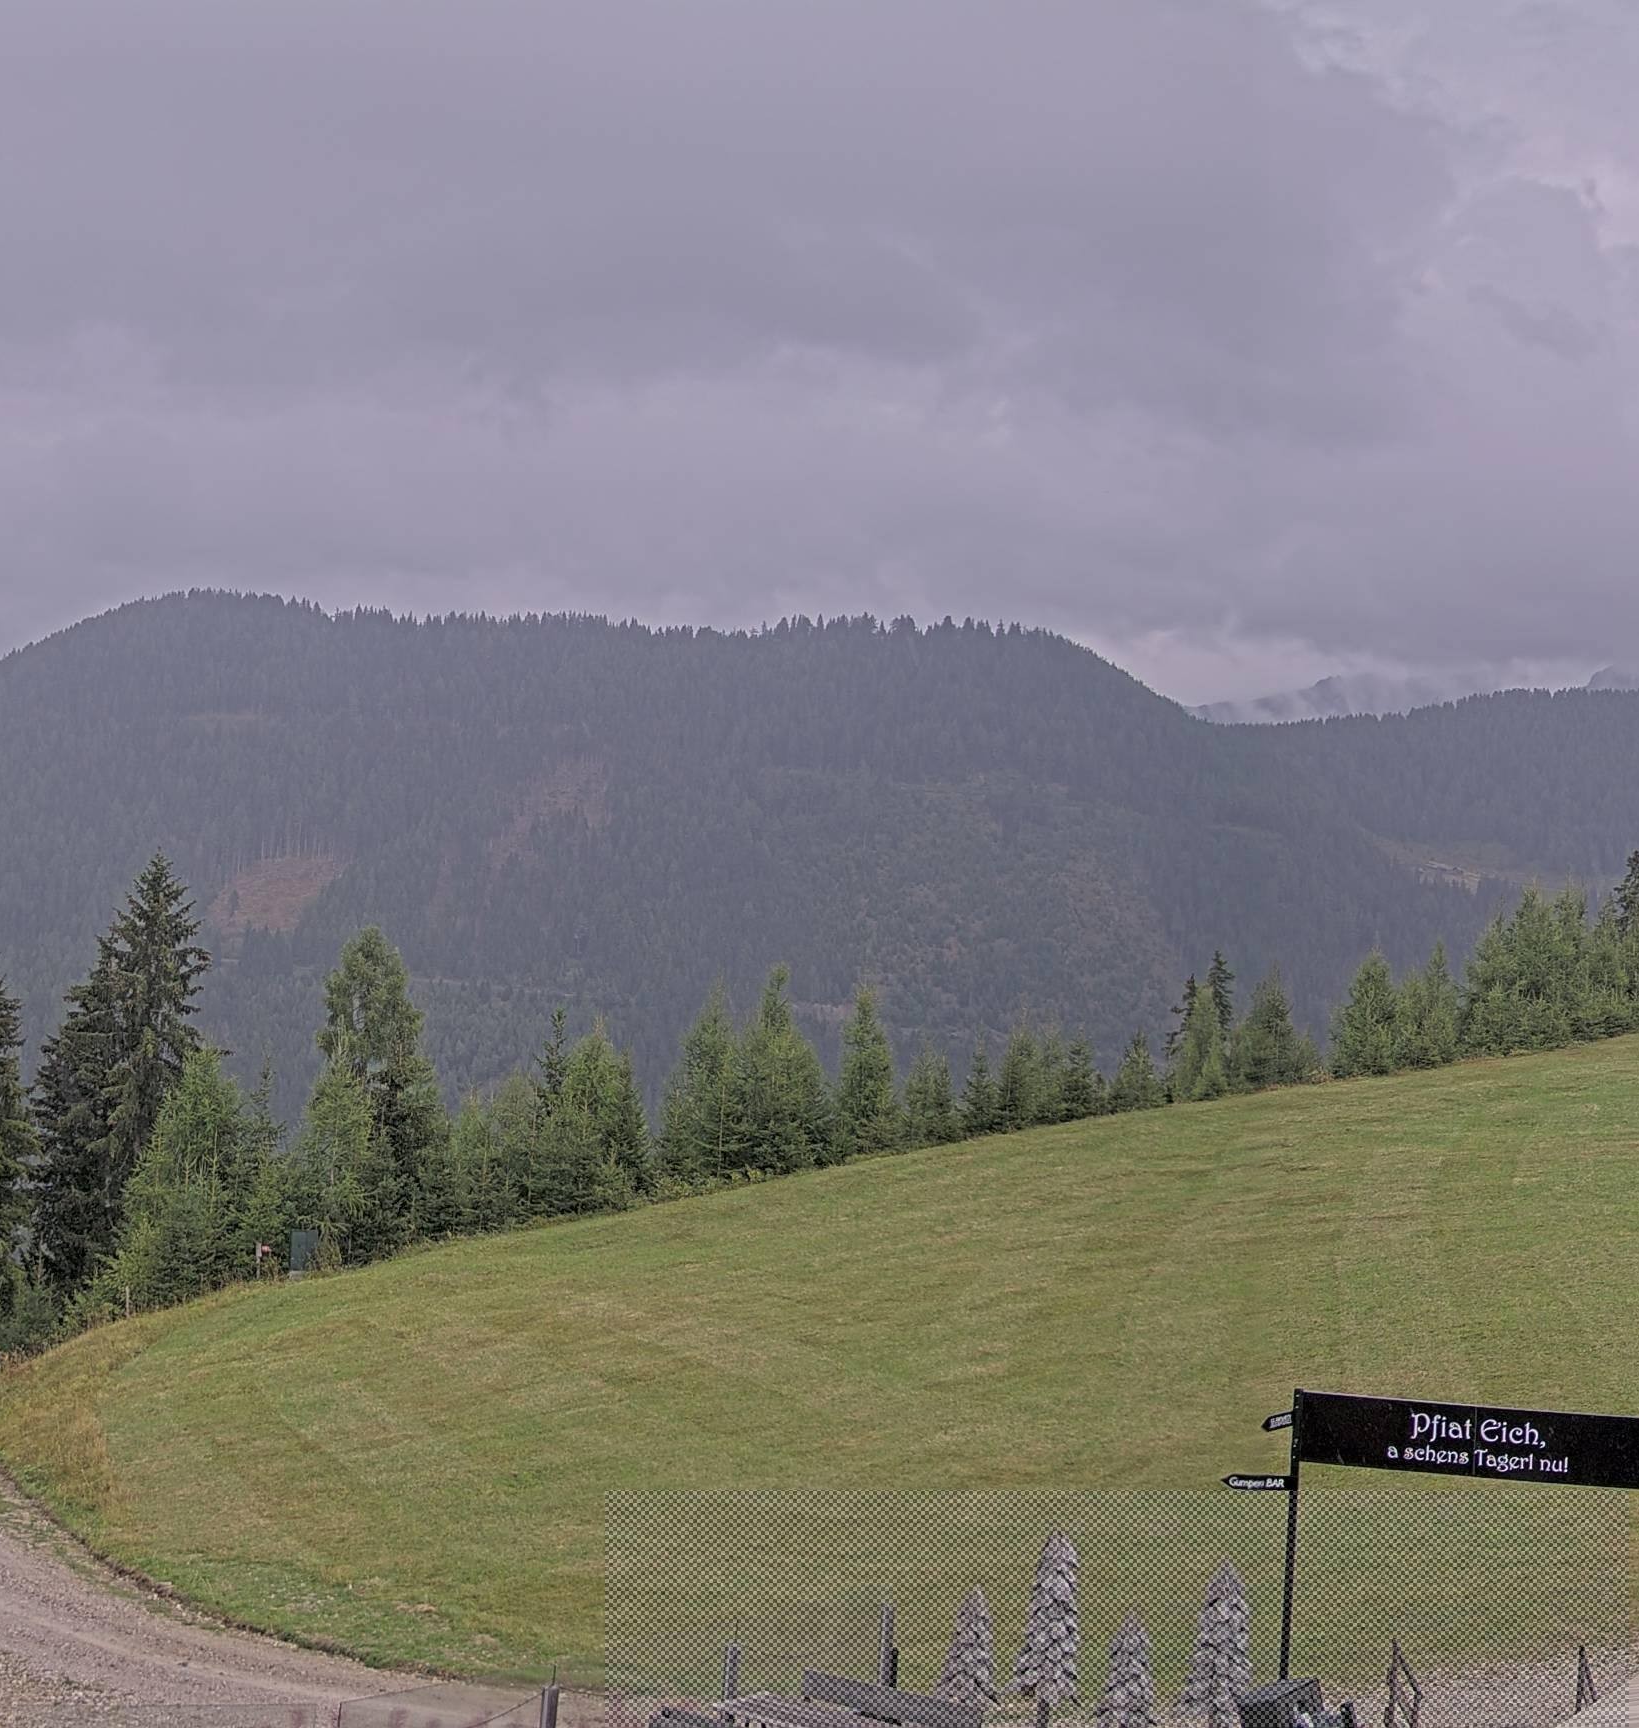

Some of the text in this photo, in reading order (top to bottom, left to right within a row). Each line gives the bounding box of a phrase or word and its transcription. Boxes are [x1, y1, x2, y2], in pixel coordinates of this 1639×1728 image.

[1410, 1412, 1546, 1449] Pfiat Eich,
[1387, 1445, 1570, 1473] a schens Tagerl nu!
[1266, 1478, 1285, 1488] BAR
